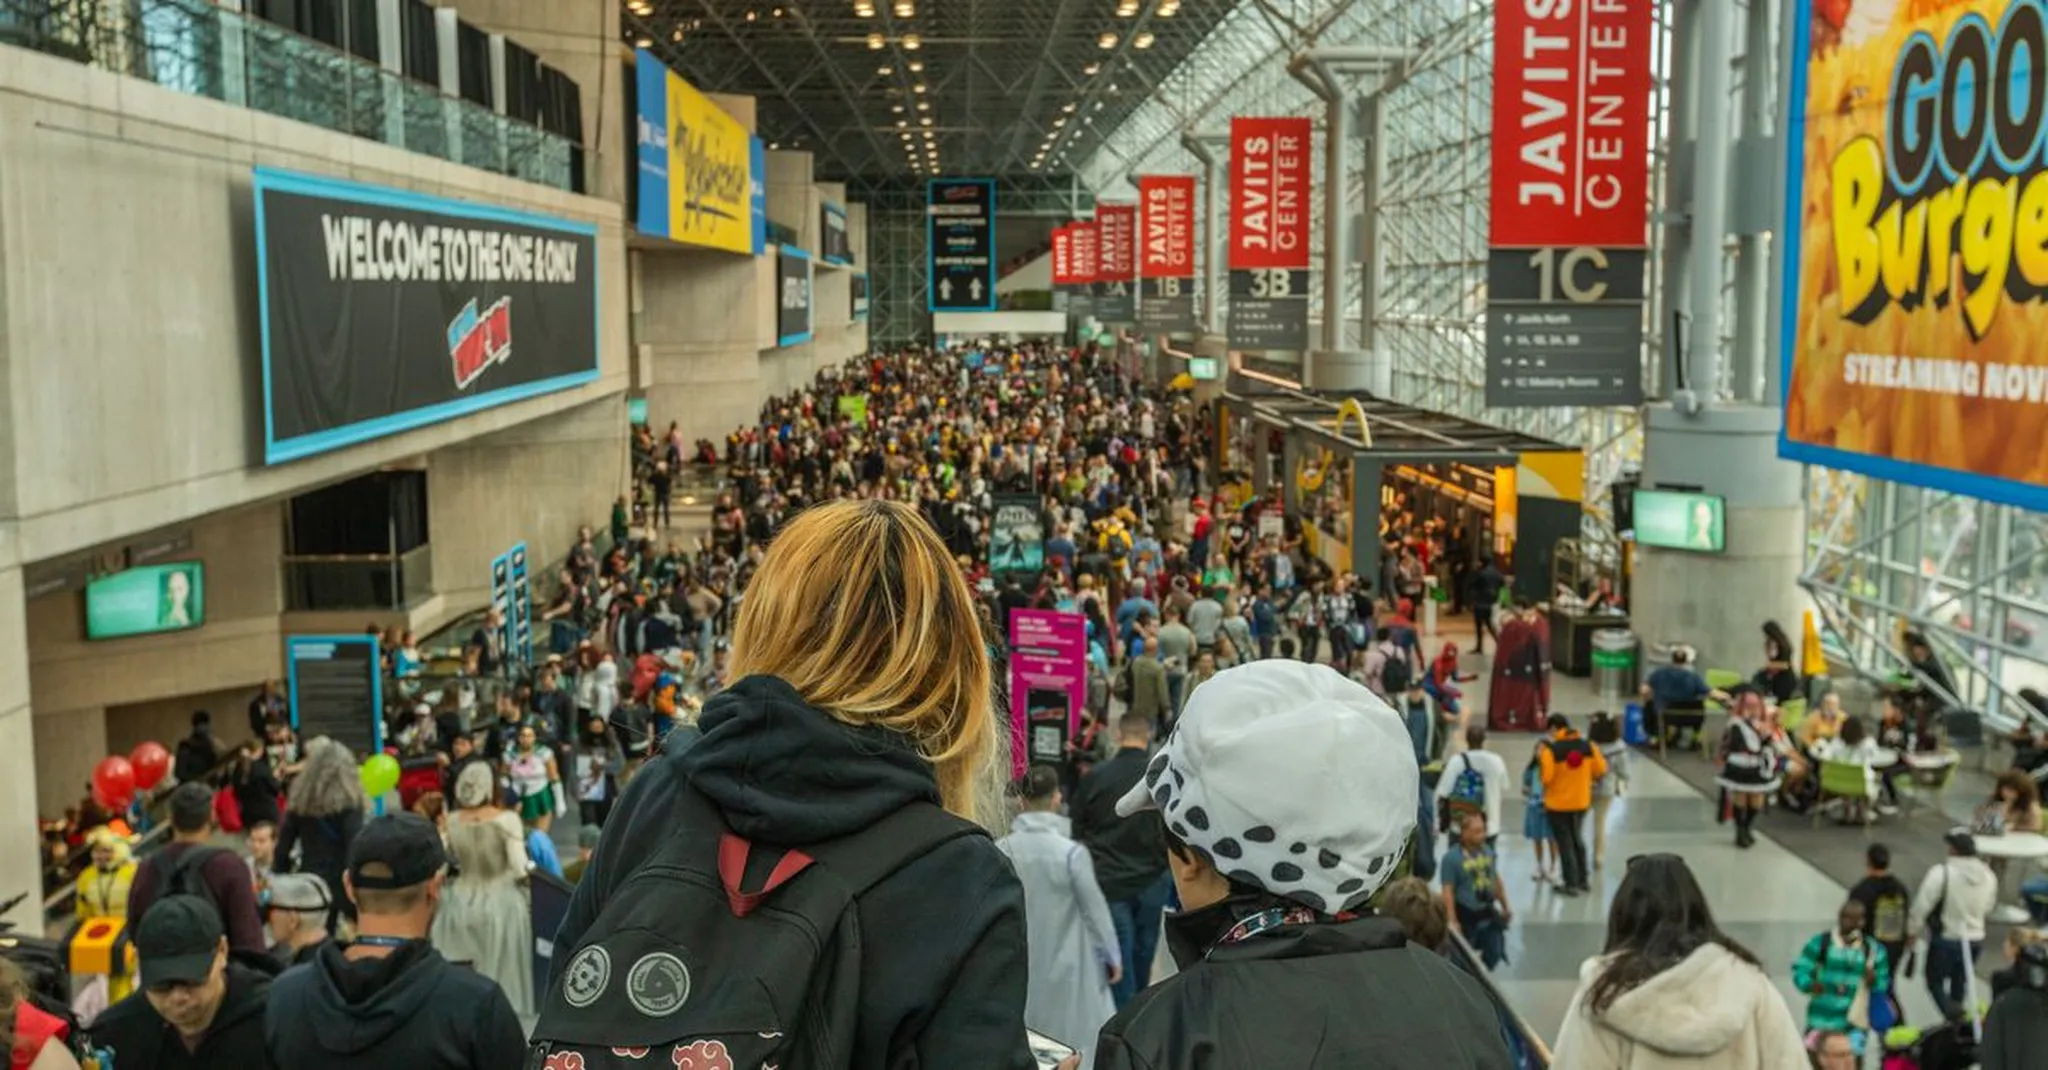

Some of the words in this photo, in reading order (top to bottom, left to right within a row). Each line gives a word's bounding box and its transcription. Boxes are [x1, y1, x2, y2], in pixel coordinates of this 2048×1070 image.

[1519, 0, 1571, 205] JAVITS
[1887, 2, 2048, 195] GOO
[1148, 188, 1167, 264] JAVITS
[1172, 187, 1186, 265] CENTER
[1243, 136, 1268, 249] JAVITS
[1277, 136, 1298, 250] CENTER
[321, 214, 440, 281] WELCOME
[441, 226, 467, 281] TO
[468, 230, 500, 281] THE
[502, 232, 533, 281] ONE
[534, 236, 544, 282] &
[545, 239, 578, 283] ONLY
[1102, 214, 1116, 271] JAVITS
[1529, 246, 1609, 303] 1C
[1832, 134, 2048, 342] Burge
[1155, 277, 1180, 297] 1B
[1250, 270, 1291, 298] 3B
[1844, 353, 1980, 396] STREAMING
